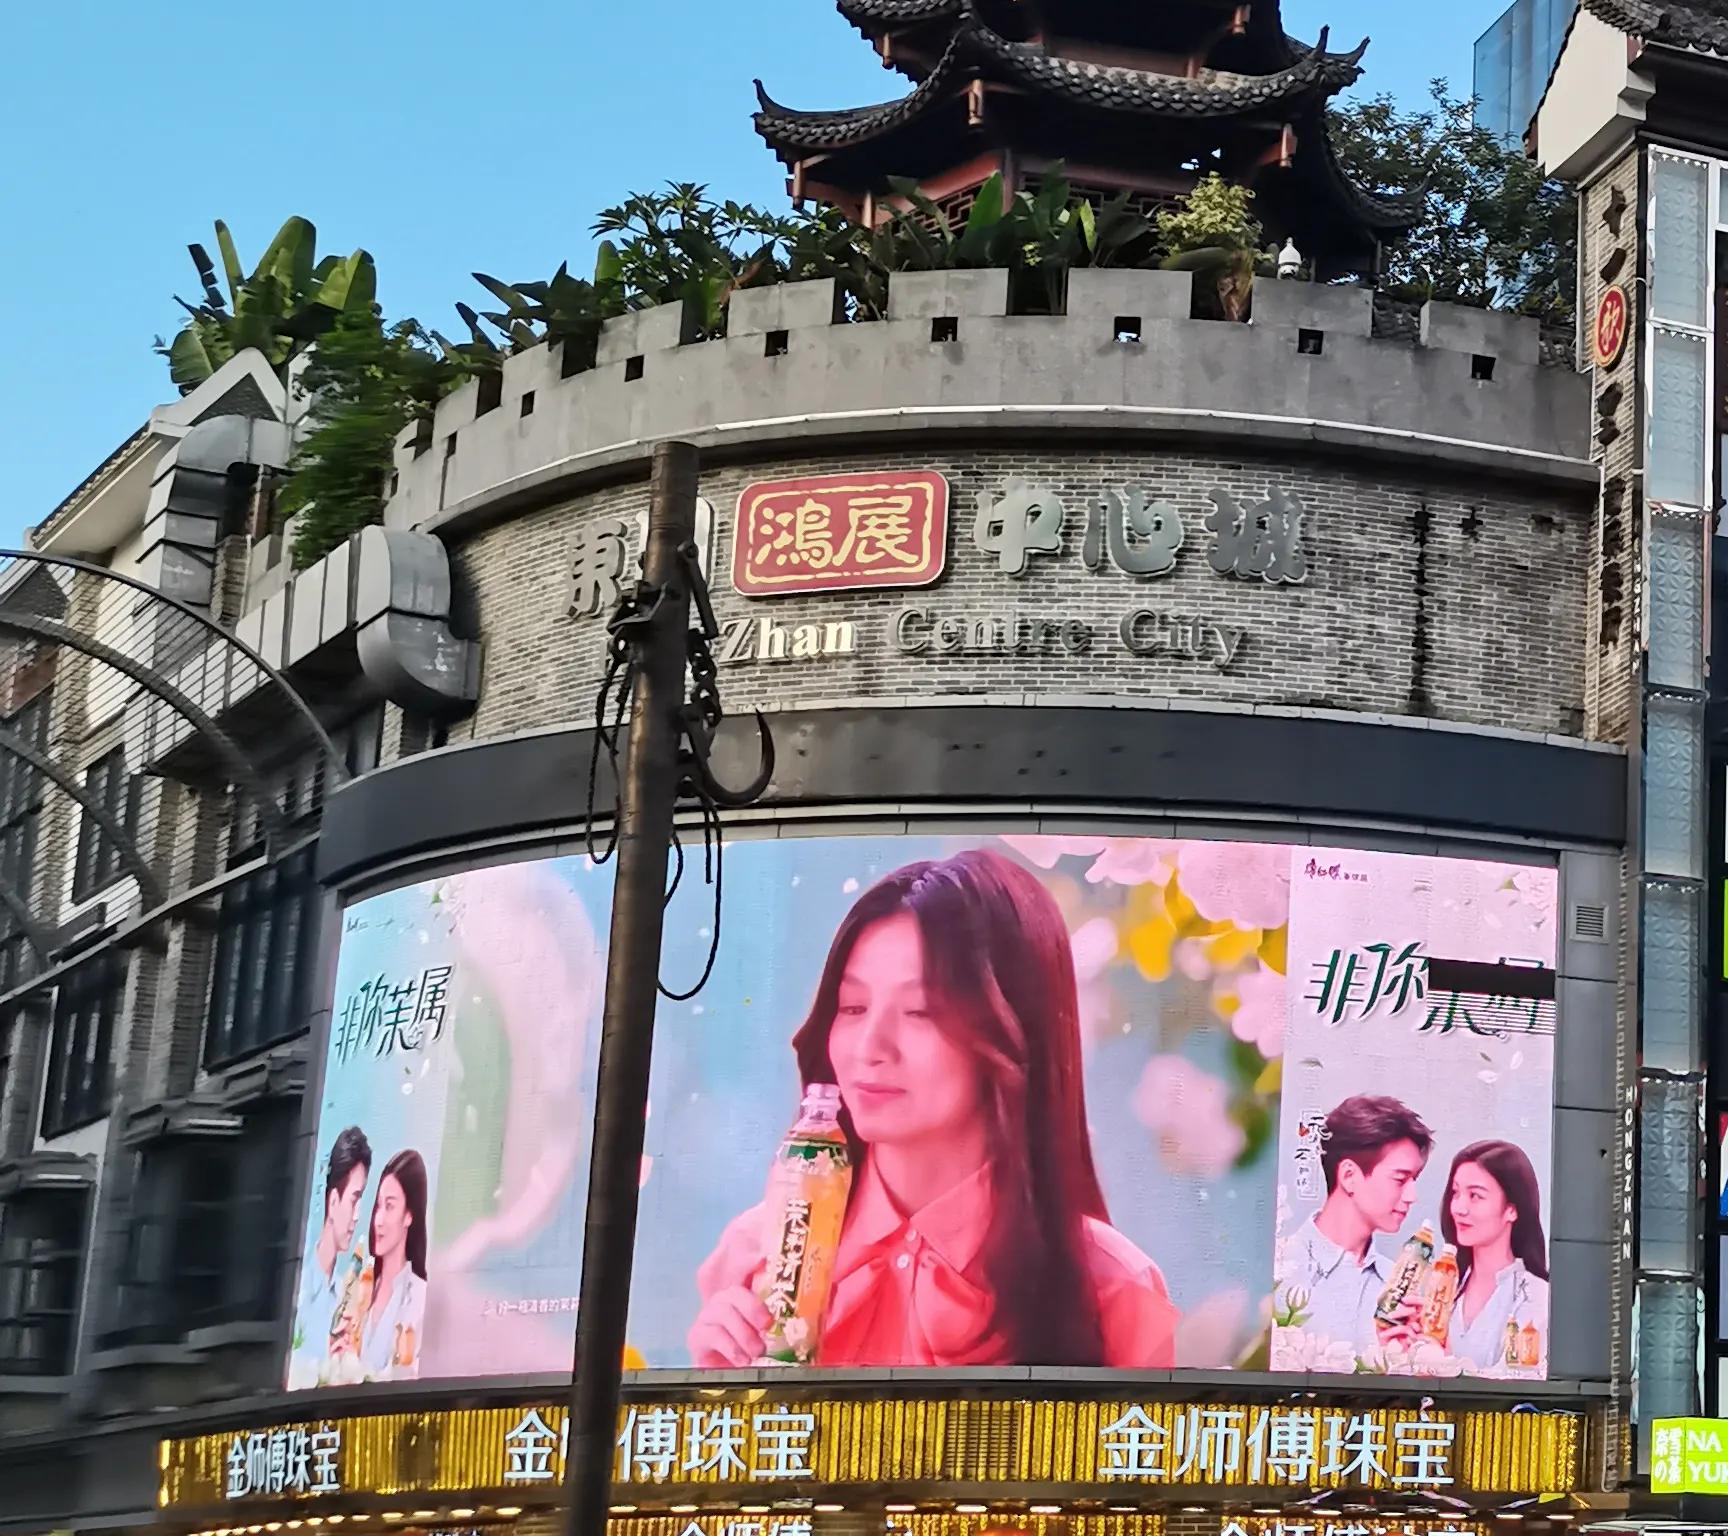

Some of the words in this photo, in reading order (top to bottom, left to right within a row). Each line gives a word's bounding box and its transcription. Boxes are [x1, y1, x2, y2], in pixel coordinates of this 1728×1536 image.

[974, 475, 1312, 585] 中心城
[719, 616, 855, 664] Zhan
[892, 608, 1092, 657] Centre
[1119, 607, 1246, 670] City
[1622, 1085, 1635, 1261] HONGZHAN
[226, 1422, 341, 1499] 金师傅珠宝
[504, 1407, 817, 1482] 金傅珠宝
[1099, 1404, 1457, 1487] 金师傅珠宝
[1687, 1429, 1722, 1453] NA
